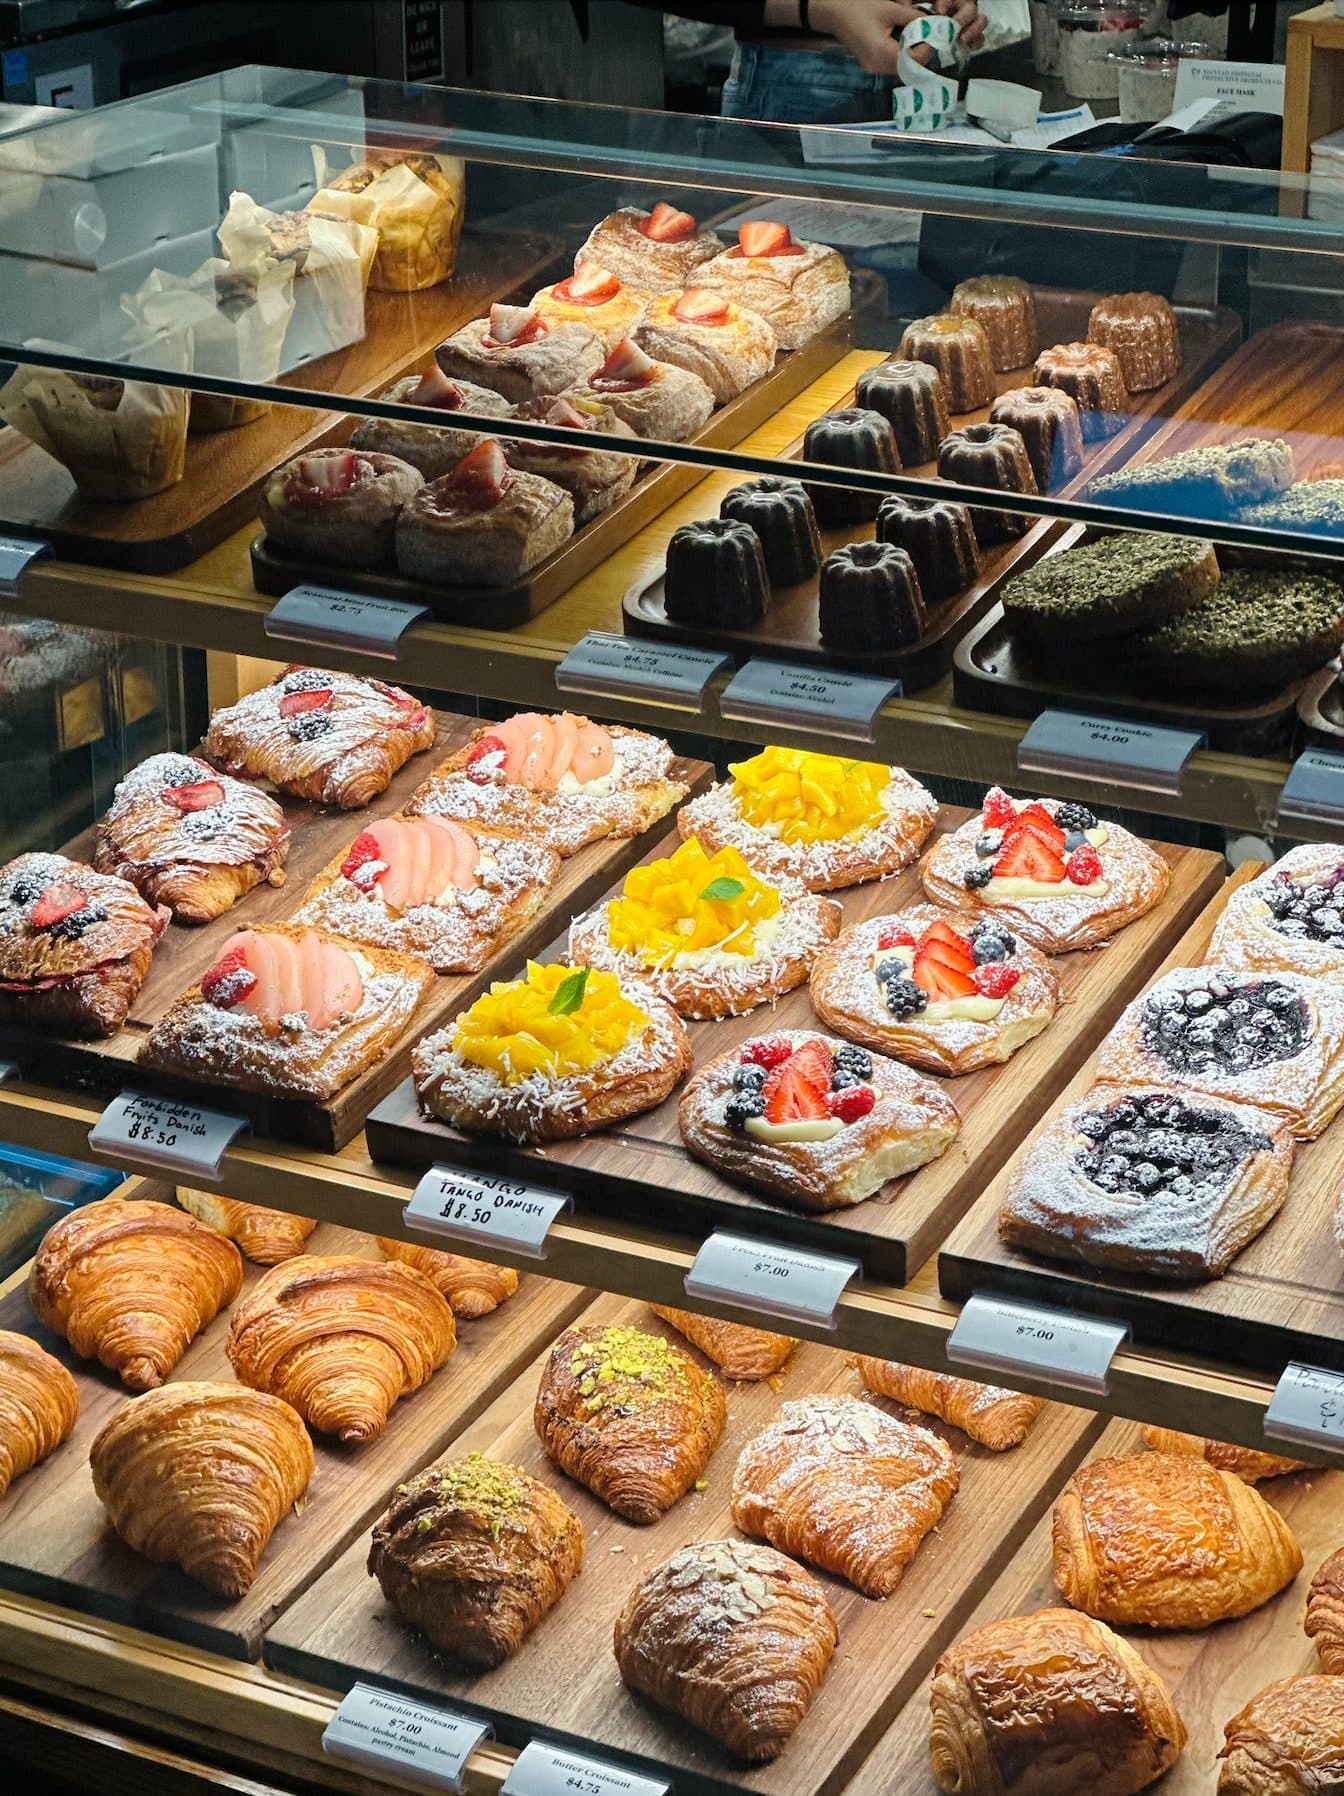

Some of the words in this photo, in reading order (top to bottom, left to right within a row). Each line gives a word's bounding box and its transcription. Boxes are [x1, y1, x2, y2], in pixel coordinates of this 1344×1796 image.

[586, 639, 609, 648] Thai
[611, 643, 631, 651] Tea
[631, 646, 676, 658] Caramel
[623, 654, 660, 666] $4.75
[781, 671, 816, 681] Vanilla
[790, 681, 827, 694] $4.50
[1081, 721, 1111, 731] Curry
[1114, 726, 1153, 738] Cookie
[1090, 731, 1129, 745] $4.00
[132, 1096, 201, 1120] Forbidden
[128, 1120, 178, 1147] $8.50
[166, 1116, 206, 1137] Danish
[439, 1181, 483, 1202] TANGO
[493, 1194, 545, 1217] DANISH
[439, 1197, 492, 1225] $8.50
[753, 1261, 790, 1278] $7.00
[1016, 1325, 1054, 1341] $7.00
[369, 1697, 413, 1717] Pistachio
[413, 1712, 460, 1732] Croissant
[388, 1717, 422, 1736] $7.00
[371, 1737, 395, 1750] pastry
[395, 1744, 416, 1756] cream
[432, 1745, 460, 1759] Almond
[551, 1757, 584, 1774] Butter
[584, 1767, 632, 1789] Croissant
[565, 1776, 602, 1795] $4.75
